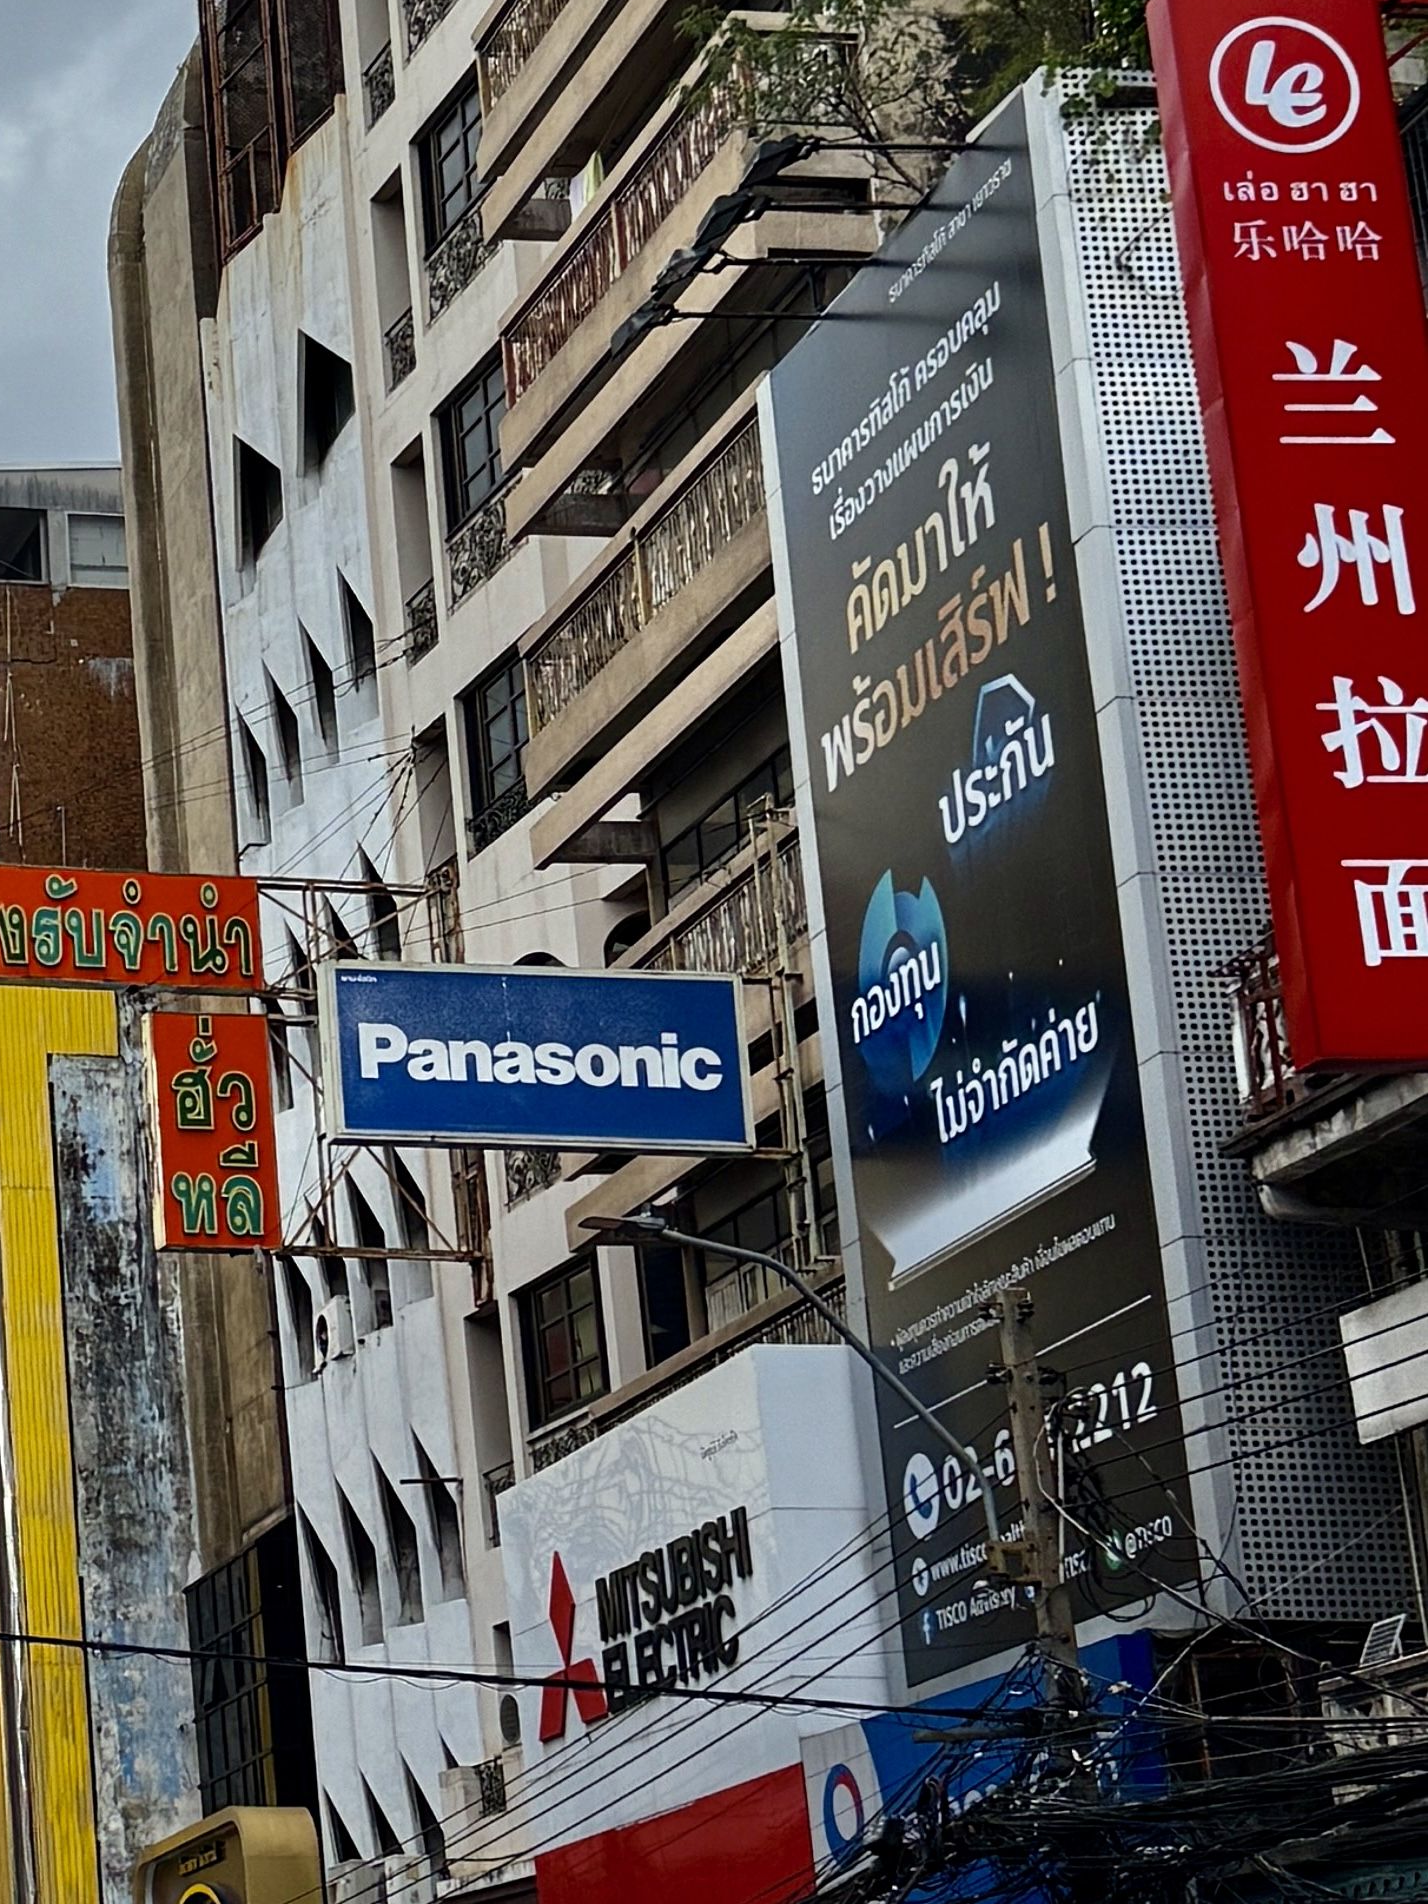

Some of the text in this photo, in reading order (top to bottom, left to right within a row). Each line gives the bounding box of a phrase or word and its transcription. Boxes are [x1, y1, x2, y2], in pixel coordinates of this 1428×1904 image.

[1233, 219, 1383, 261] 乐哈哈
[811, 280, 1002, 496] ธนาคารทิสโก้ ครอบคลุม
[845, 440, 995, 656] คัดมาให้
[939, 712, 1056, 845] ประกัน
[357, 1022, 725, 1093] Panasonic
[849, 941, 941, 1045] กองทุน
[929, 1000, 1100, 1145] ไม่จำกัดค่าย
[594, 1505, 754, 1643] MITSUBISHI
[601, 1594, 741, 1716] ELECTRIC
